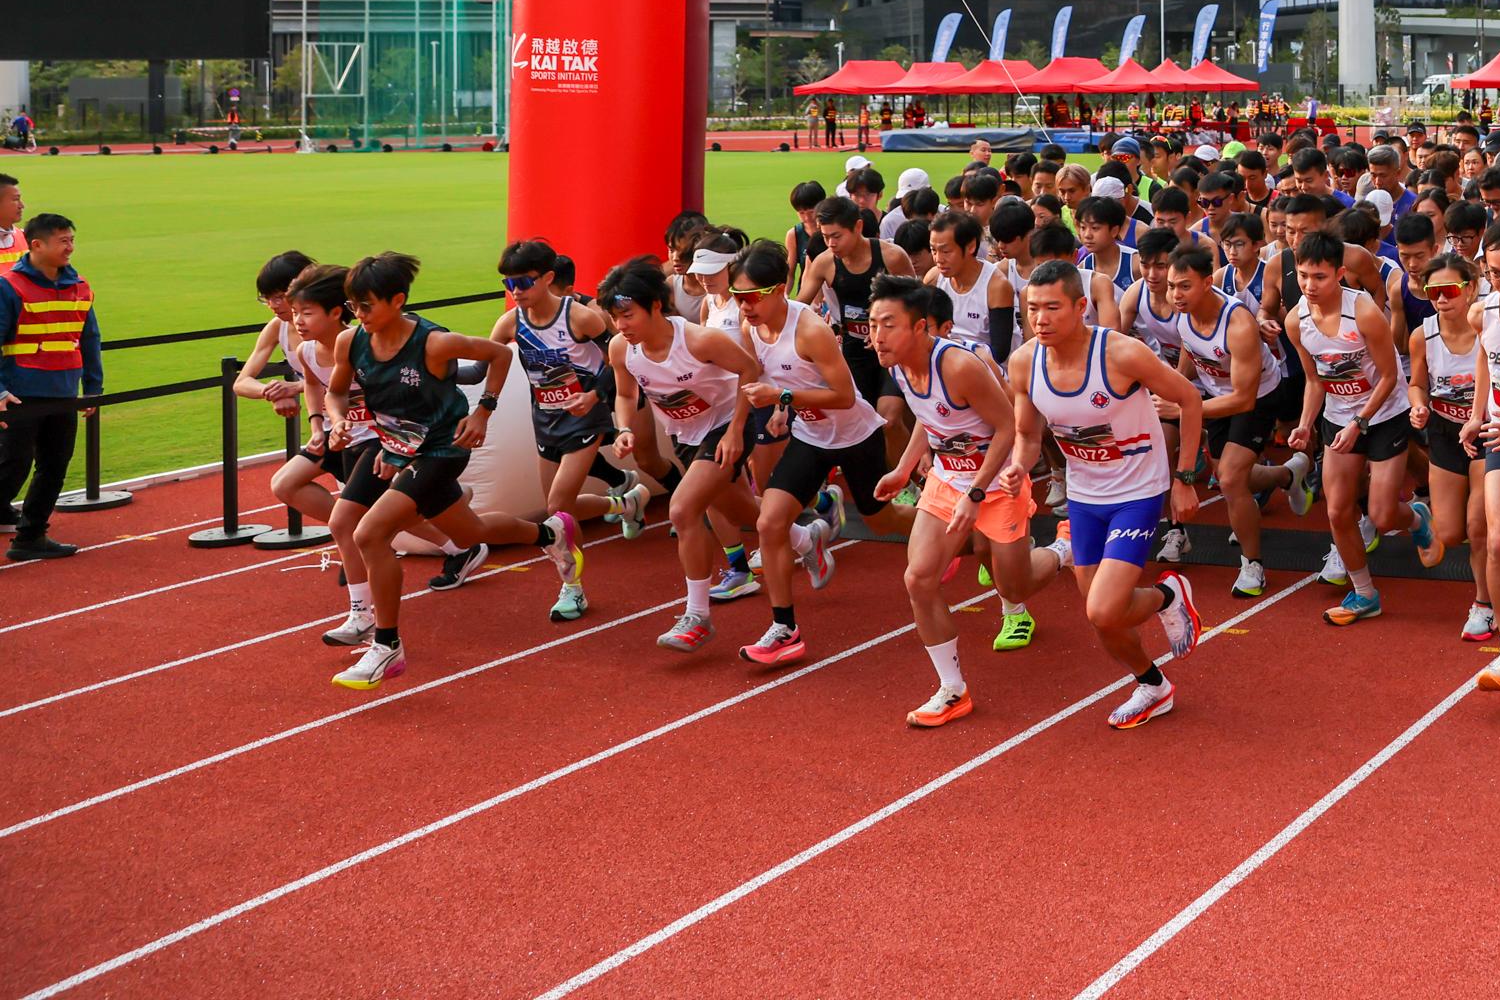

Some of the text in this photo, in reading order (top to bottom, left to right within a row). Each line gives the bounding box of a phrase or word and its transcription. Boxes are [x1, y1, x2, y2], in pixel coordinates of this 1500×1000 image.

[531, 37, 598, 55] 飛越啟德
[531, 55, 598, 72] KAI TAK
[531, 71, 599, 82] SPORTS INITIATIVE
[541, 387, 572, 402] 2061
[1330, 383, 1362, 394] 1005
[667, 405, 700, 419] 1138
[1069, 445, 1110, 460] 1072
[946, 457, 976, 470] 1040
